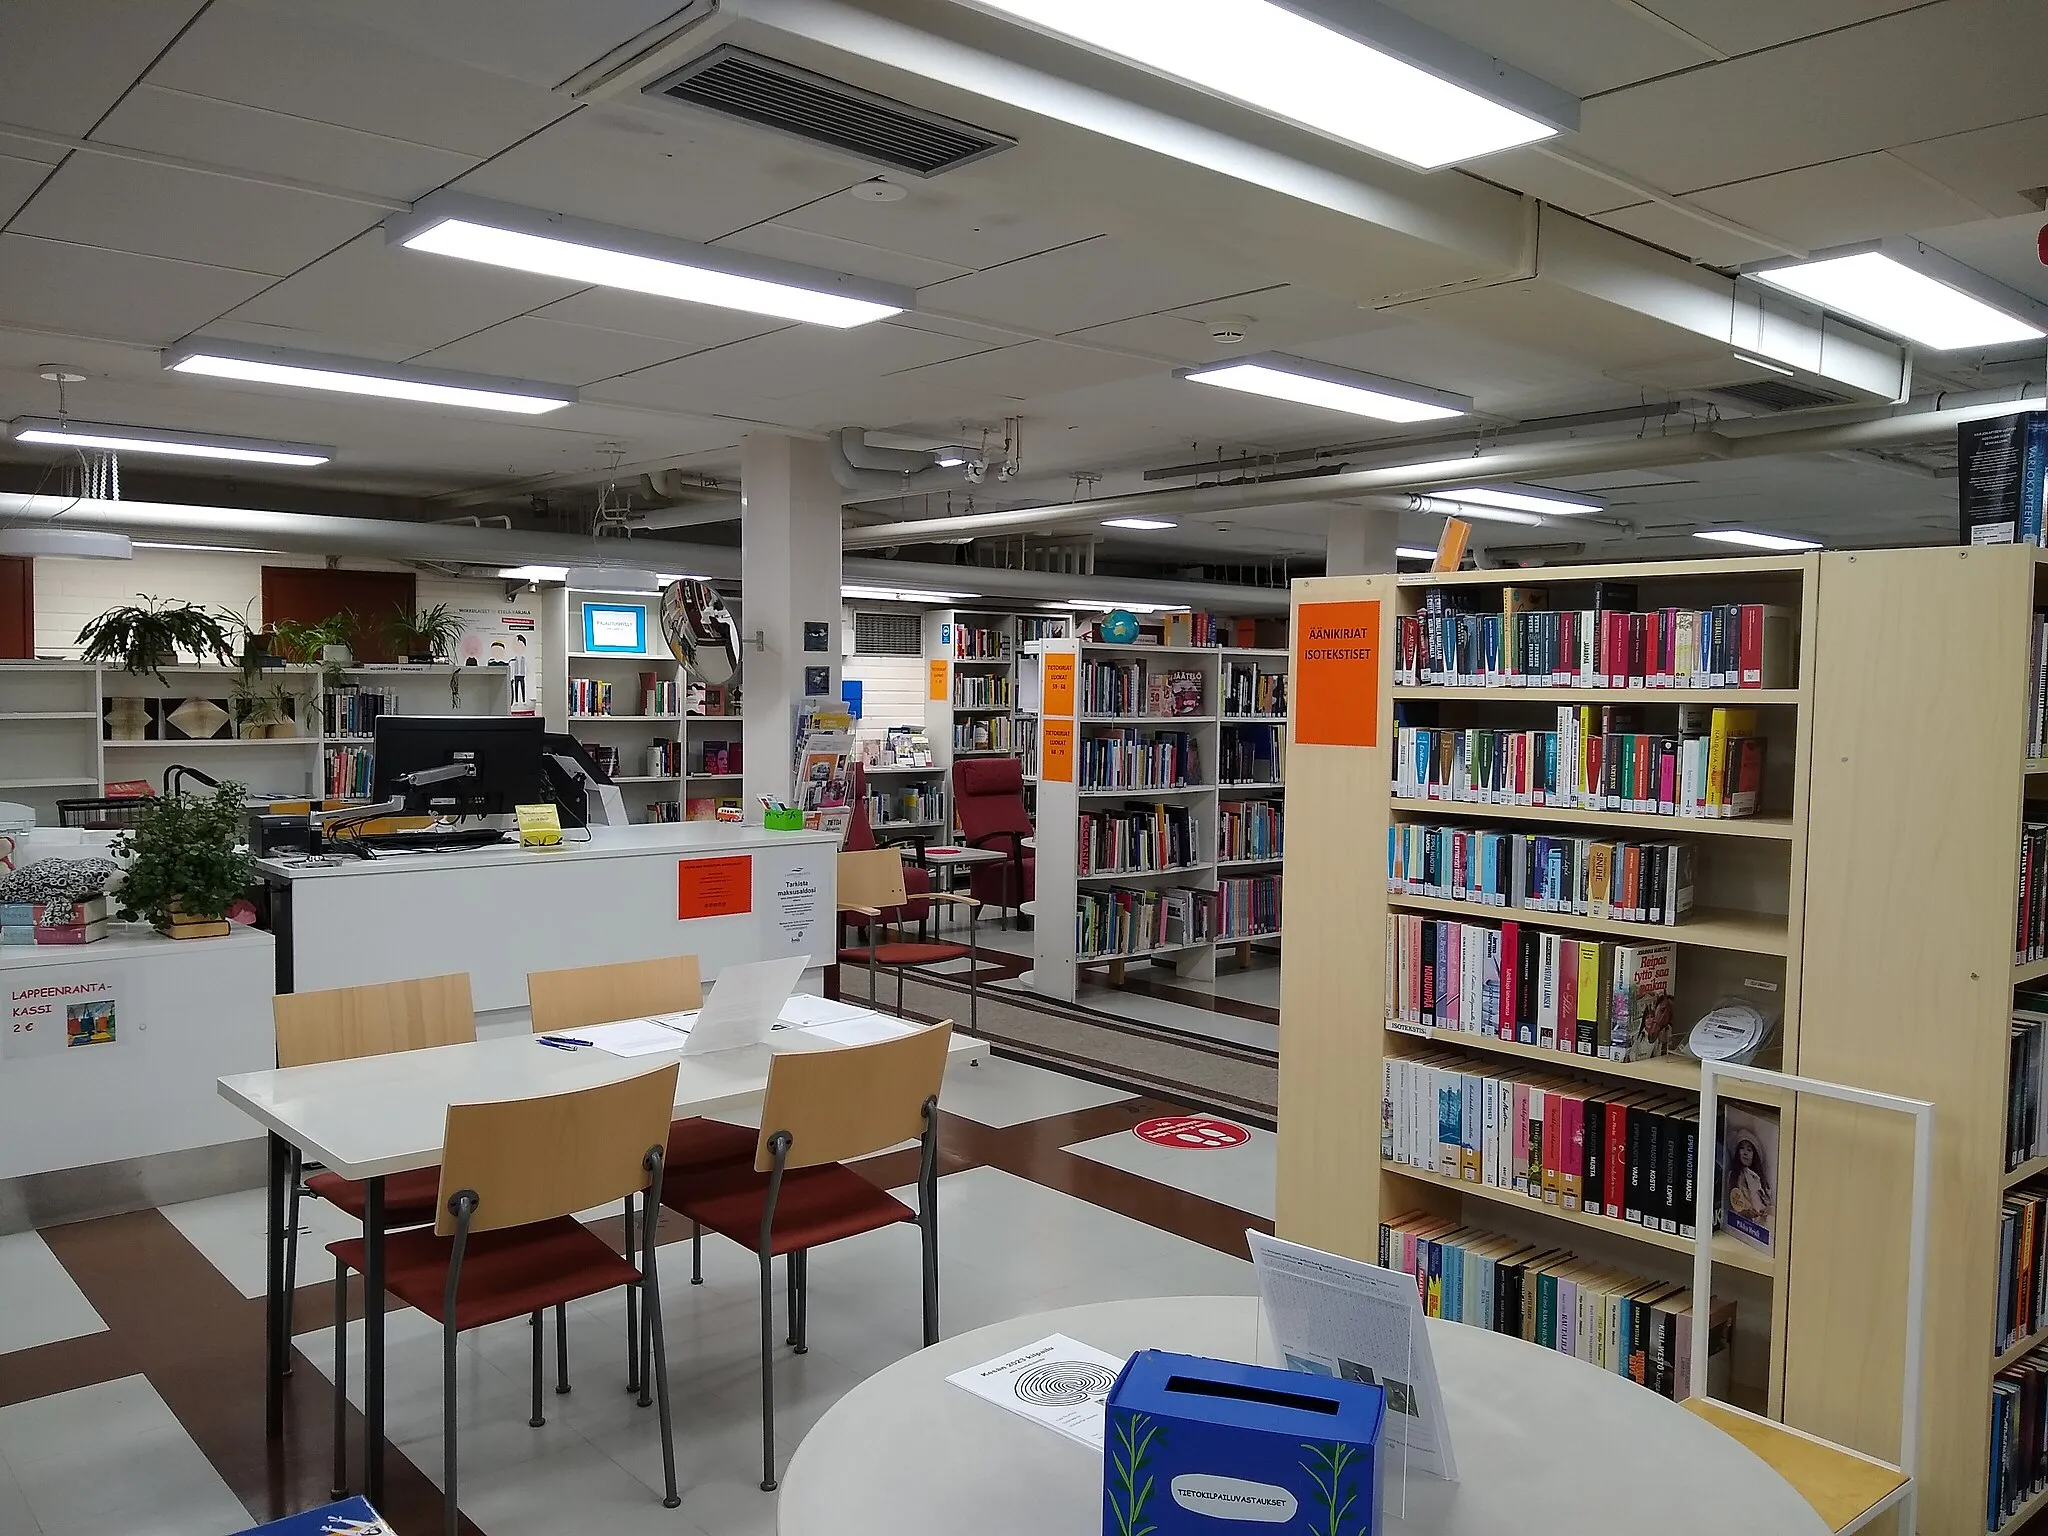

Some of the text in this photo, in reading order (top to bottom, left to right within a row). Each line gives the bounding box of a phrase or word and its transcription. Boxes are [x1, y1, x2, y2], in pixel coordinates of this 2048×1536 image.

[2024, 445, 2037, 528] VARJOKAPTEENI
[1308, 627, 1368, 640] ÄÄNIKIRJAT
[1304, 648, 1371, 660] ISOTEKSTISET
[1047, 664, 1072, 672] TIETOKIRJAT
[1172, 672, 1202, 680] JÄÄTELÖ
[1712, 730, 1720, 762] NAURAVIA
[1595, 852, 1603, 882] SINUHE
[777, 886, 817, 897] maksusaldosi
[1640, 955, 1667, 970] Reipas
[1655, 968, 1670, 979] saa
[12, 983, 112, 1001] LAPPEENRANTA-
[1423, 965, 1433, 1008] HARJUNPÄÄ
[12, 1004, 52, 1018] KASSI
[13, 1022, 34, 1033] 2 €
[980, 1364, 1007, 1377] Kesän
[1006, 1357, 1027, 1368] 2023
[1026, 1346, 1054, 1360] kilpailu
[1178, 1488, 1286, 1507] TIETOKILPAILUVASTAUKSET
